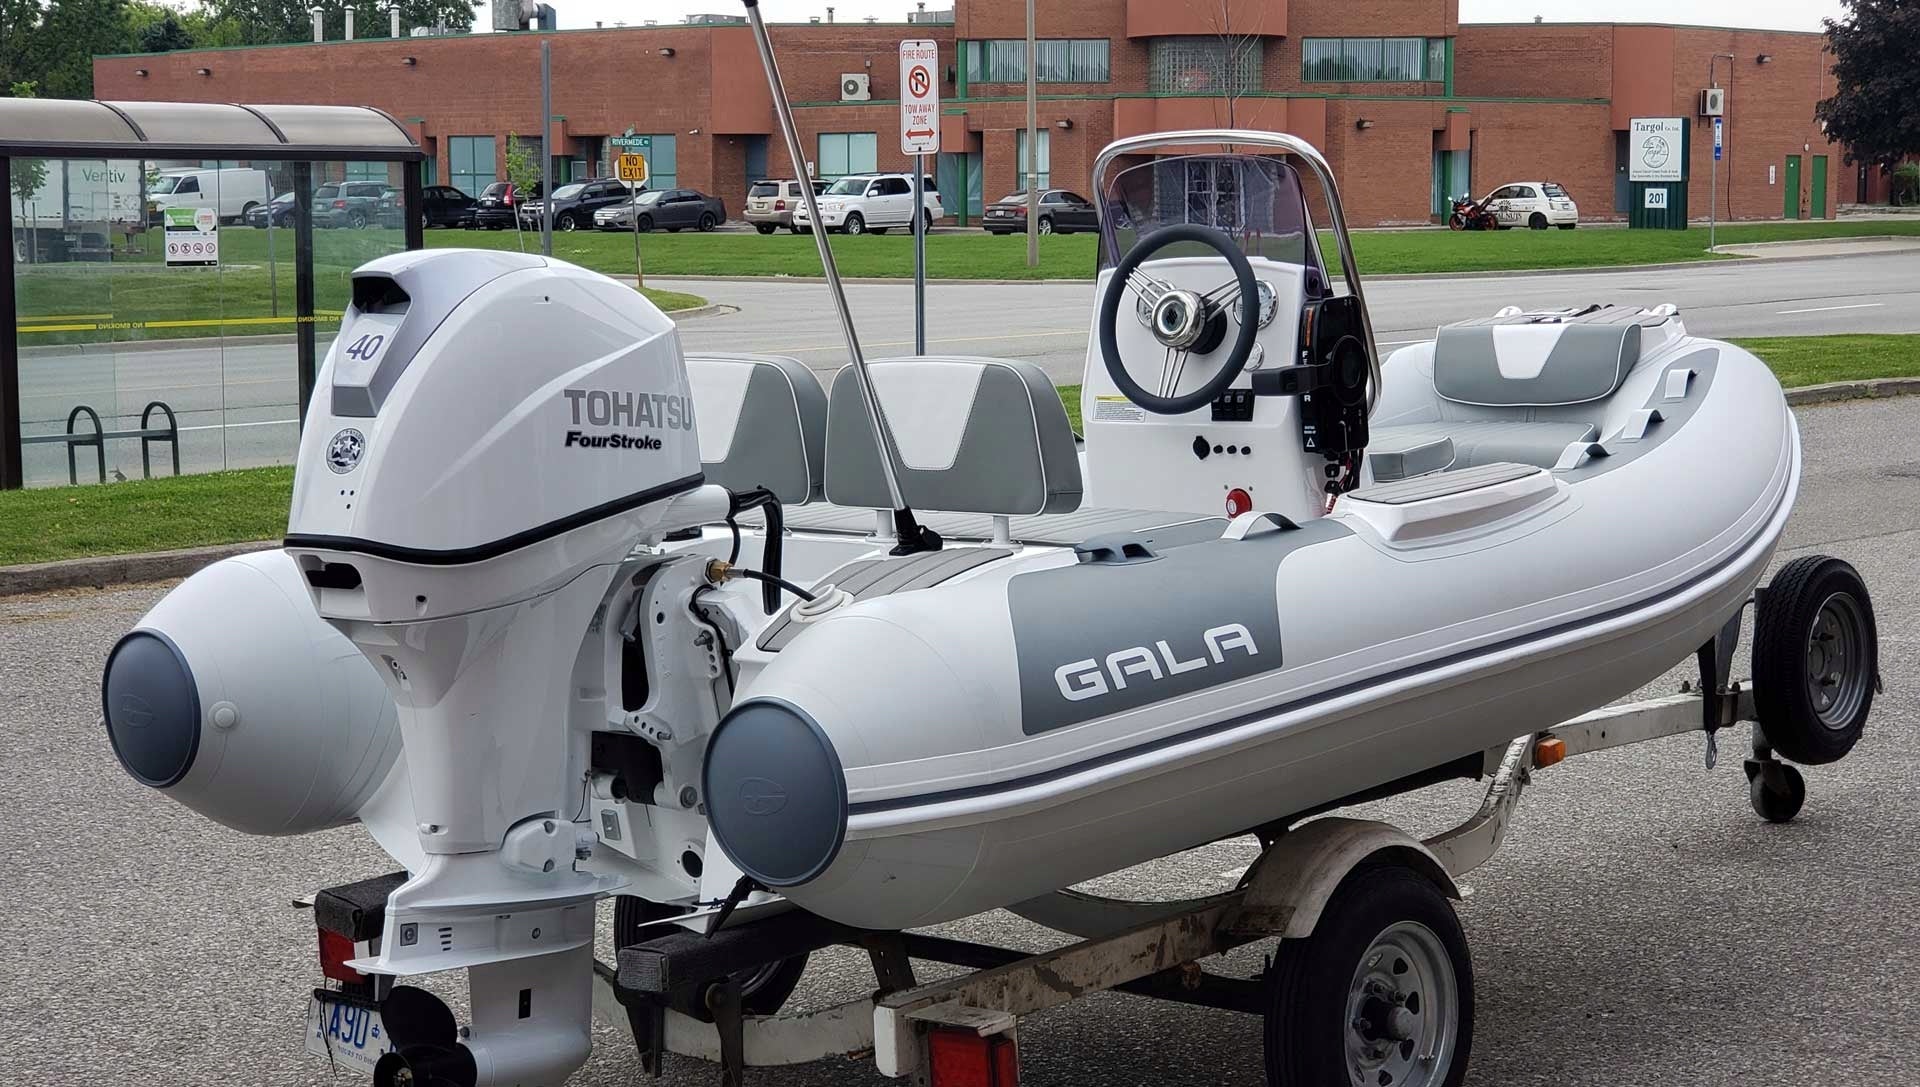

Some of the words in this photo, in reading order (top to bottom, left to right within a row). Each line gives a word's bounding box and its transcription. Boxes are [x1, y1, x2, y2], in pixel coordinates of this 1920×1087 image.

[903, 49, 915, 59] FIRE
[916, 49, 935, 59] ROUTE
[905, 104, 917, 114] TOW
[919, 103, 935, 113] AWAY
[912, 115, 928, 125] ZONE
[1634, 122, 1664, 133] Targol
[626, 156, 638, 166] NO
[623, 167, 642, 178] EXIT
[1648, 193, 1664, 204] 201
[346, 335, 384, 361] 40
[564, 389, 692, 431] TOHATSU
[565, 430, 662, 449] FourStroke
[1054, 623, 1258, 701] GALA
